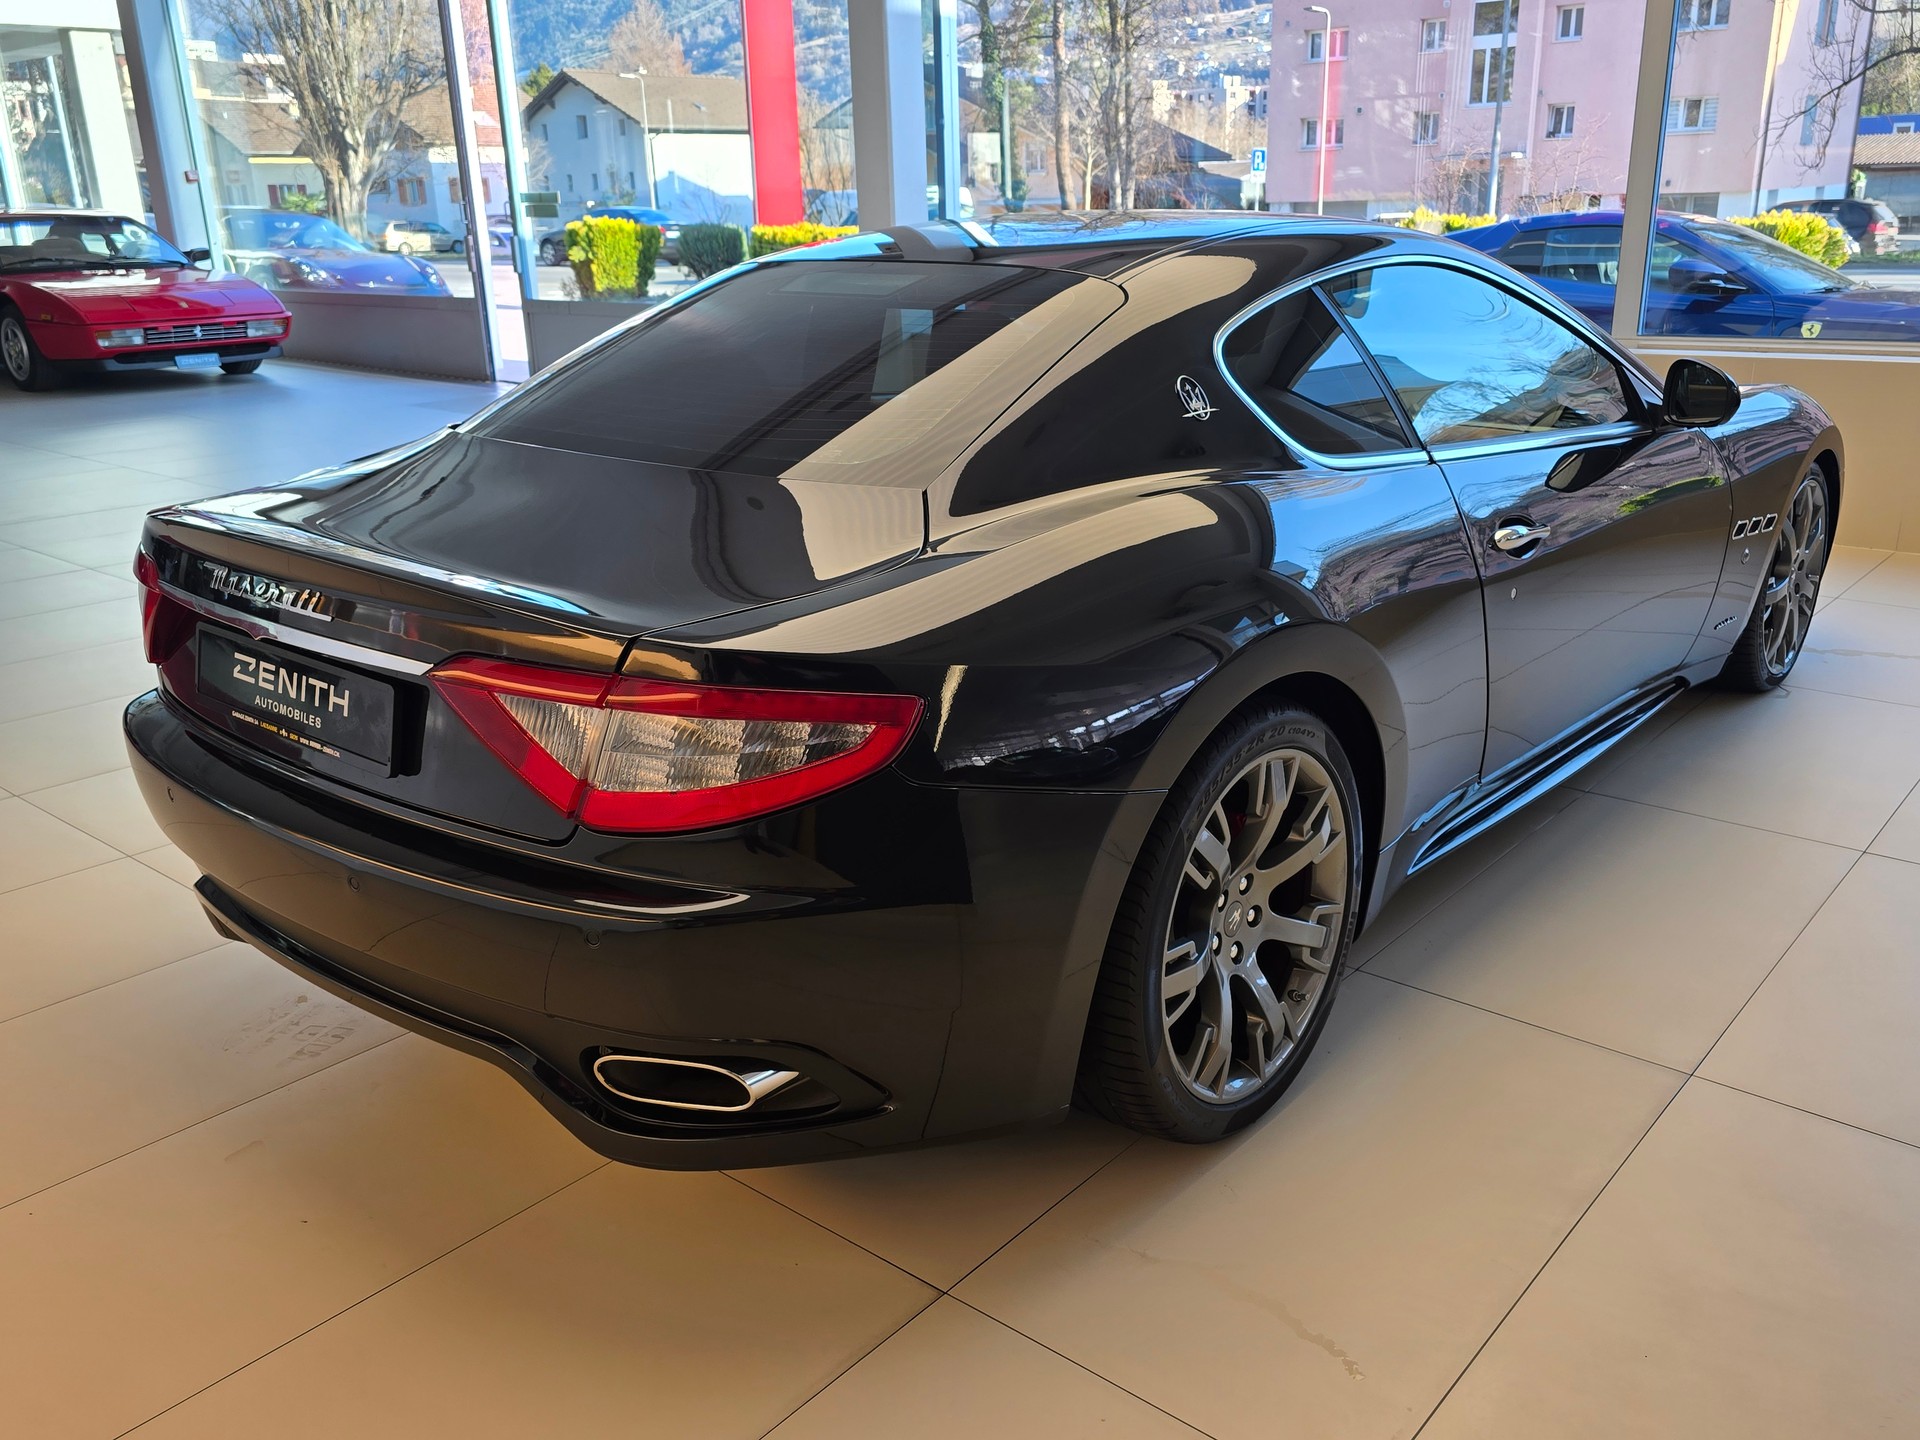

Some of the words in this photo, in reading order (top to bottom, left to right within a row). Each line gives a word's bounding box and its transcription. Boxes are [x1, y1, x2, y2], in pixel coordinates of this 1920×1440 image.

[203, 561, 332, 622] Maserati
[233, 652, 350, 717] ZENITH
[254, 695, 322, 729] AUTOMOBILES
[1268, 726, 1285, 739] 20
